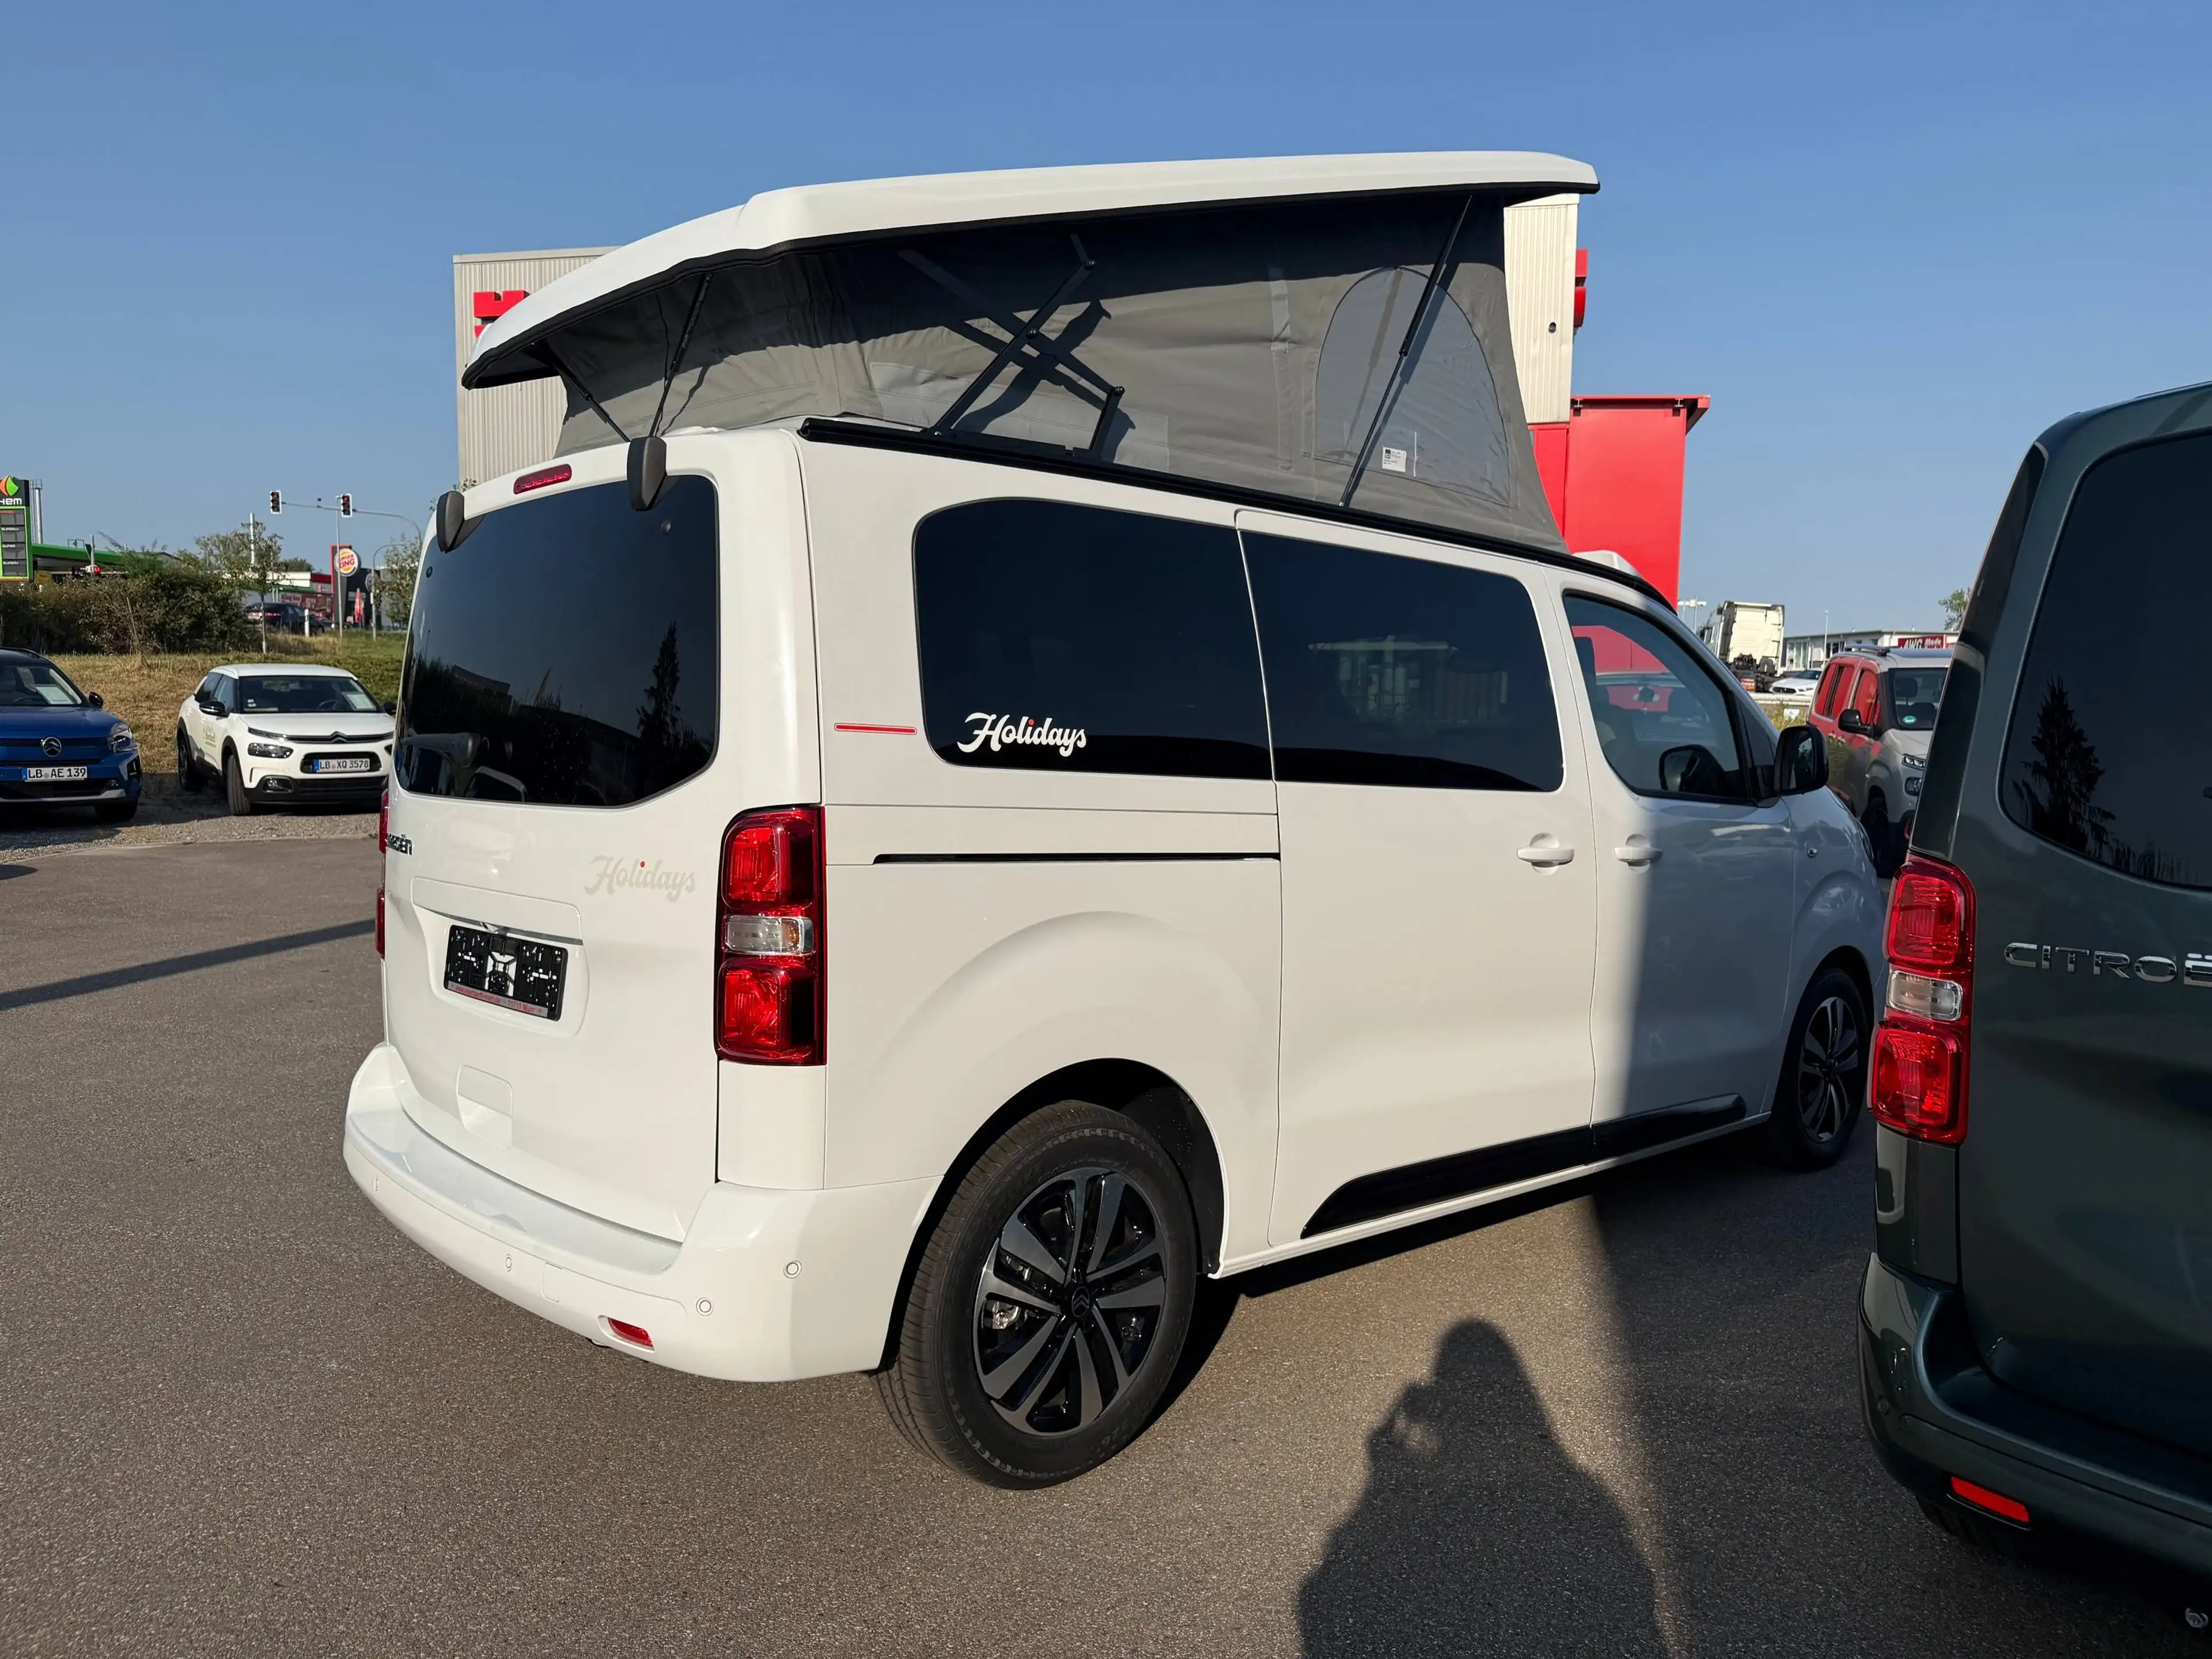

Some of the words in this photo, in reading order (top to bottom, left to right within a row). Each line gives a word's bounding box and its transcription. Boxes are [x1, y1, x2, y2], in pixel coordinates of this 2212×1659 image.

[957, 712, 1087, 757] Holidays
[28, 769, 43, 778] LB
[51, 768, 64, 778] AE
[67, 768, 86, 777] 139
[320, 761, 330, 770] LB
[336, 760, 347, 769] XQ
[349, 760, 369, 768] 3578
[583, 855, 695, 903] Holidays
